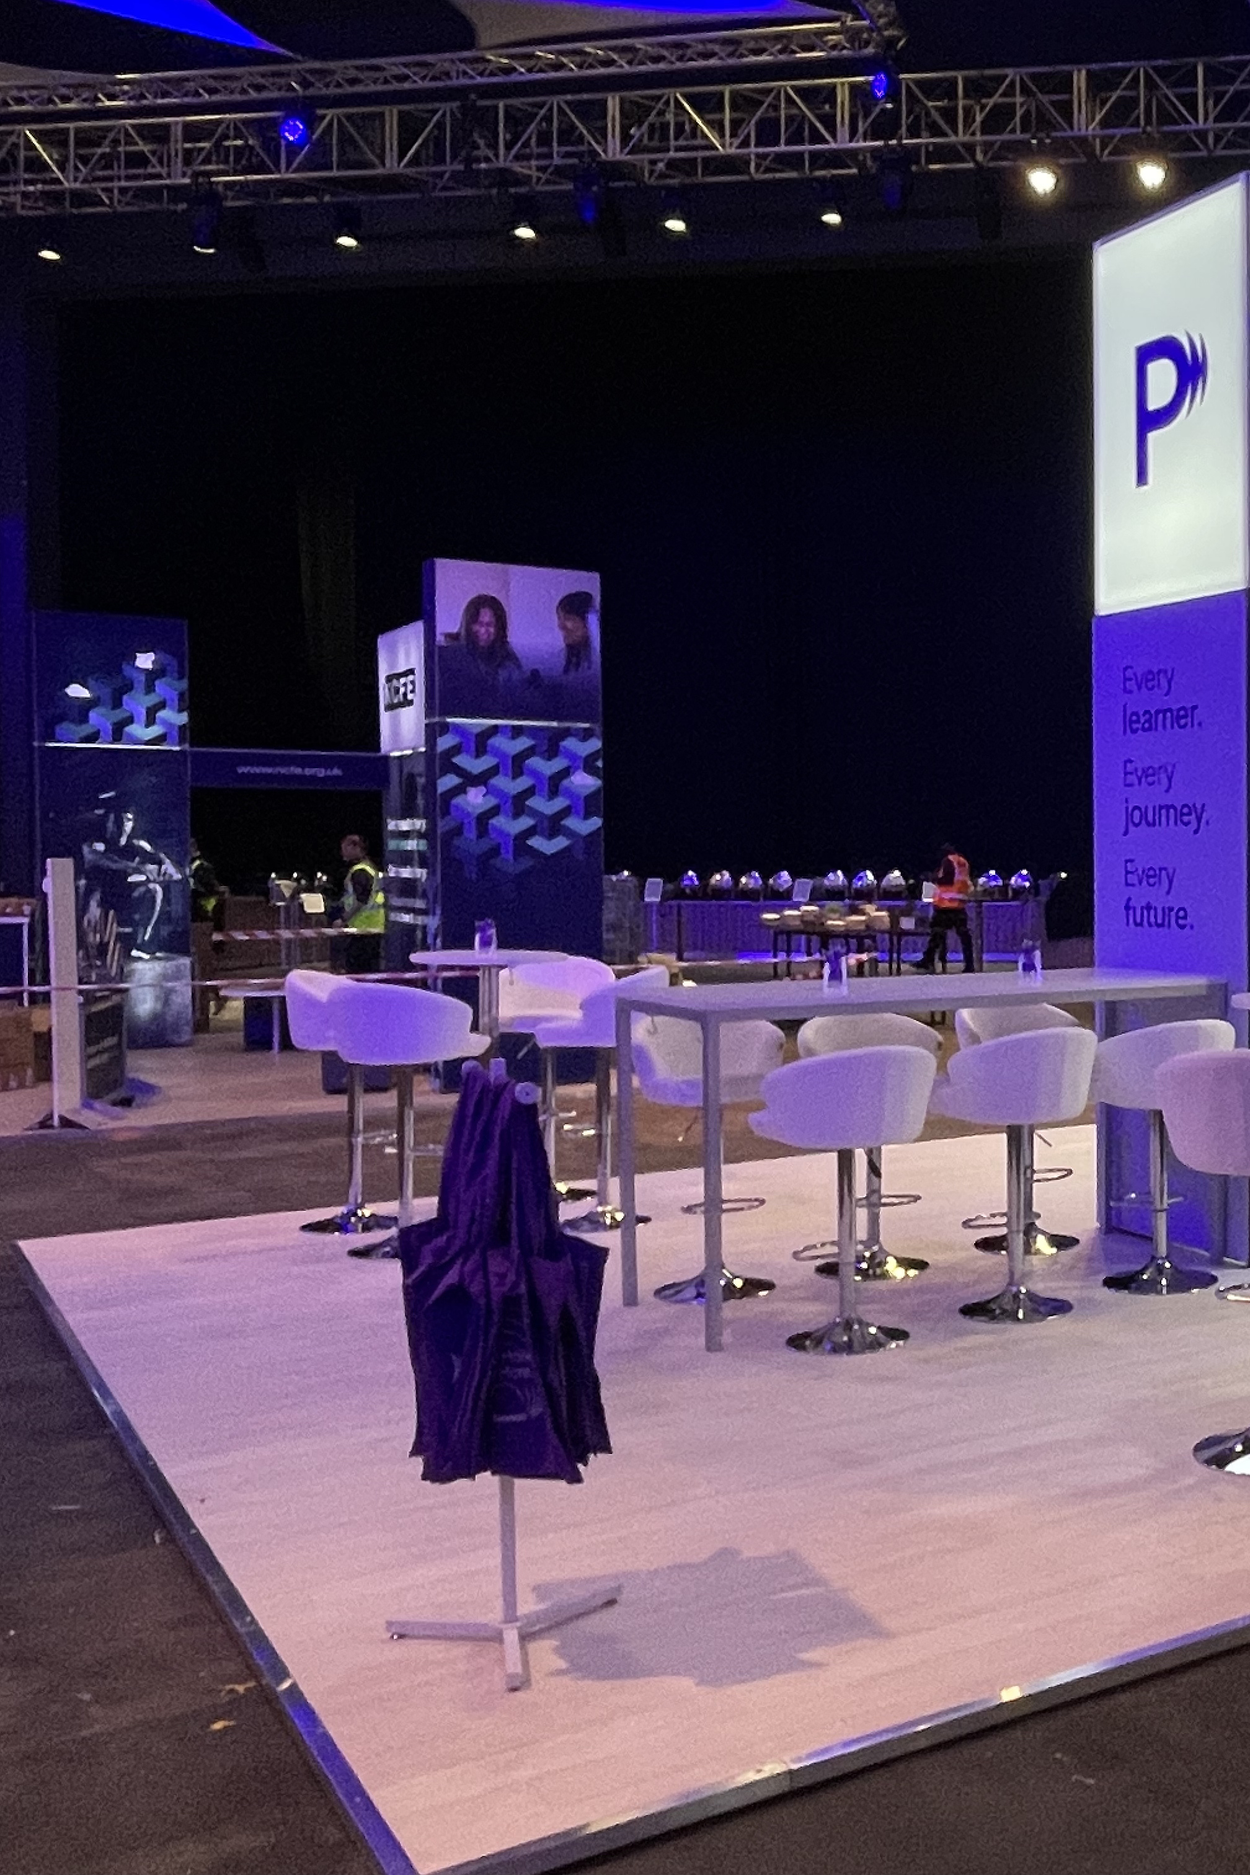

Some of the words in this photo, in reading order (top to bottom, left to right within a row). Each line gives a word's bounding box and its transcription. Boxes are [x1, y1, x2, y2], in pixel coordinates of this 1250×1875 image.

[1122, 665, 1175, 697] Every
[1122, 702, 1202, 736] learner.
[1123, 758, 1177, 793] Every
[1122, 797, 1210, 837] journey.
[1124, 858, 1177, 896] Every
[1123, 896, 1195, 931] future.
